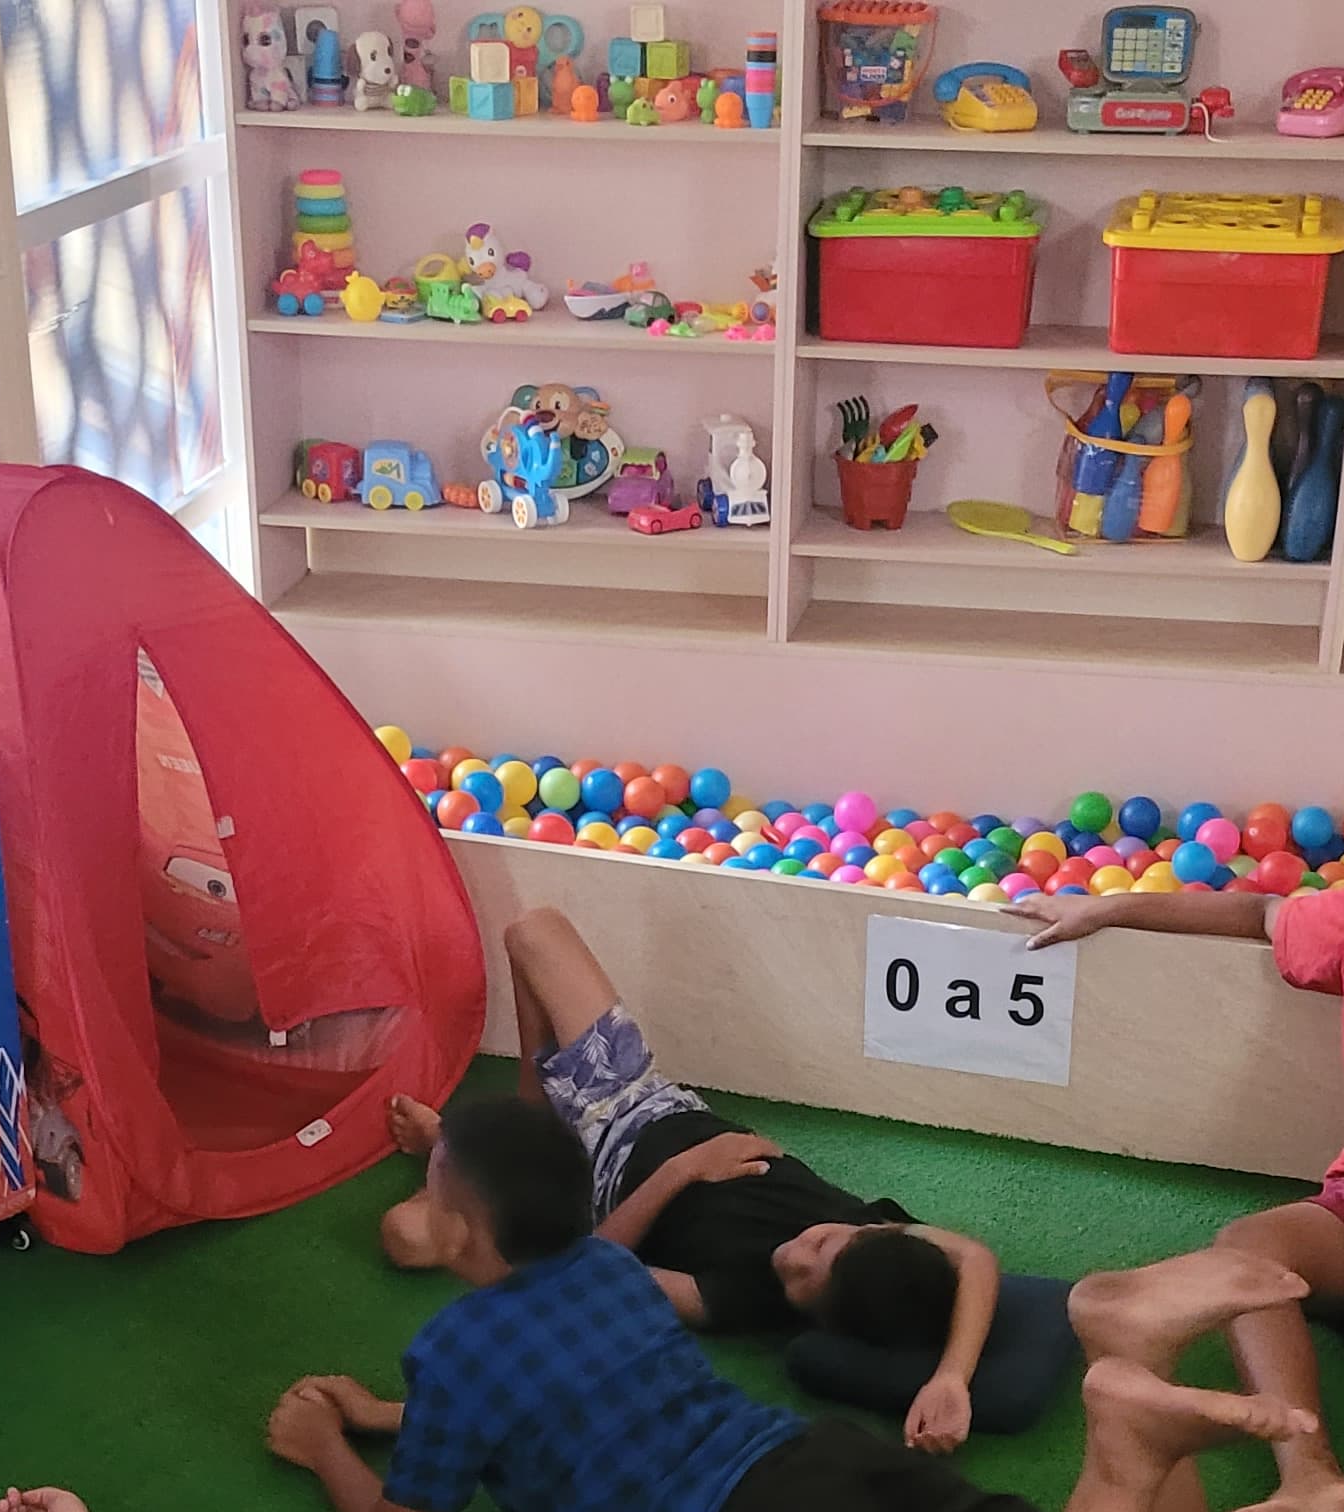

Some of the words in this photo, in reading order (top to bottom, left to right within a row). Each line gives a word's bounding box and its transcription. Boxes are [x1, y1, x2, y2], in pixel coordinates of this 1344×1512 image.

[886, 958, 919, 1011] 0
[945, 979, 981, 1020] a
[1008, 974, 1044, 1026] 5
